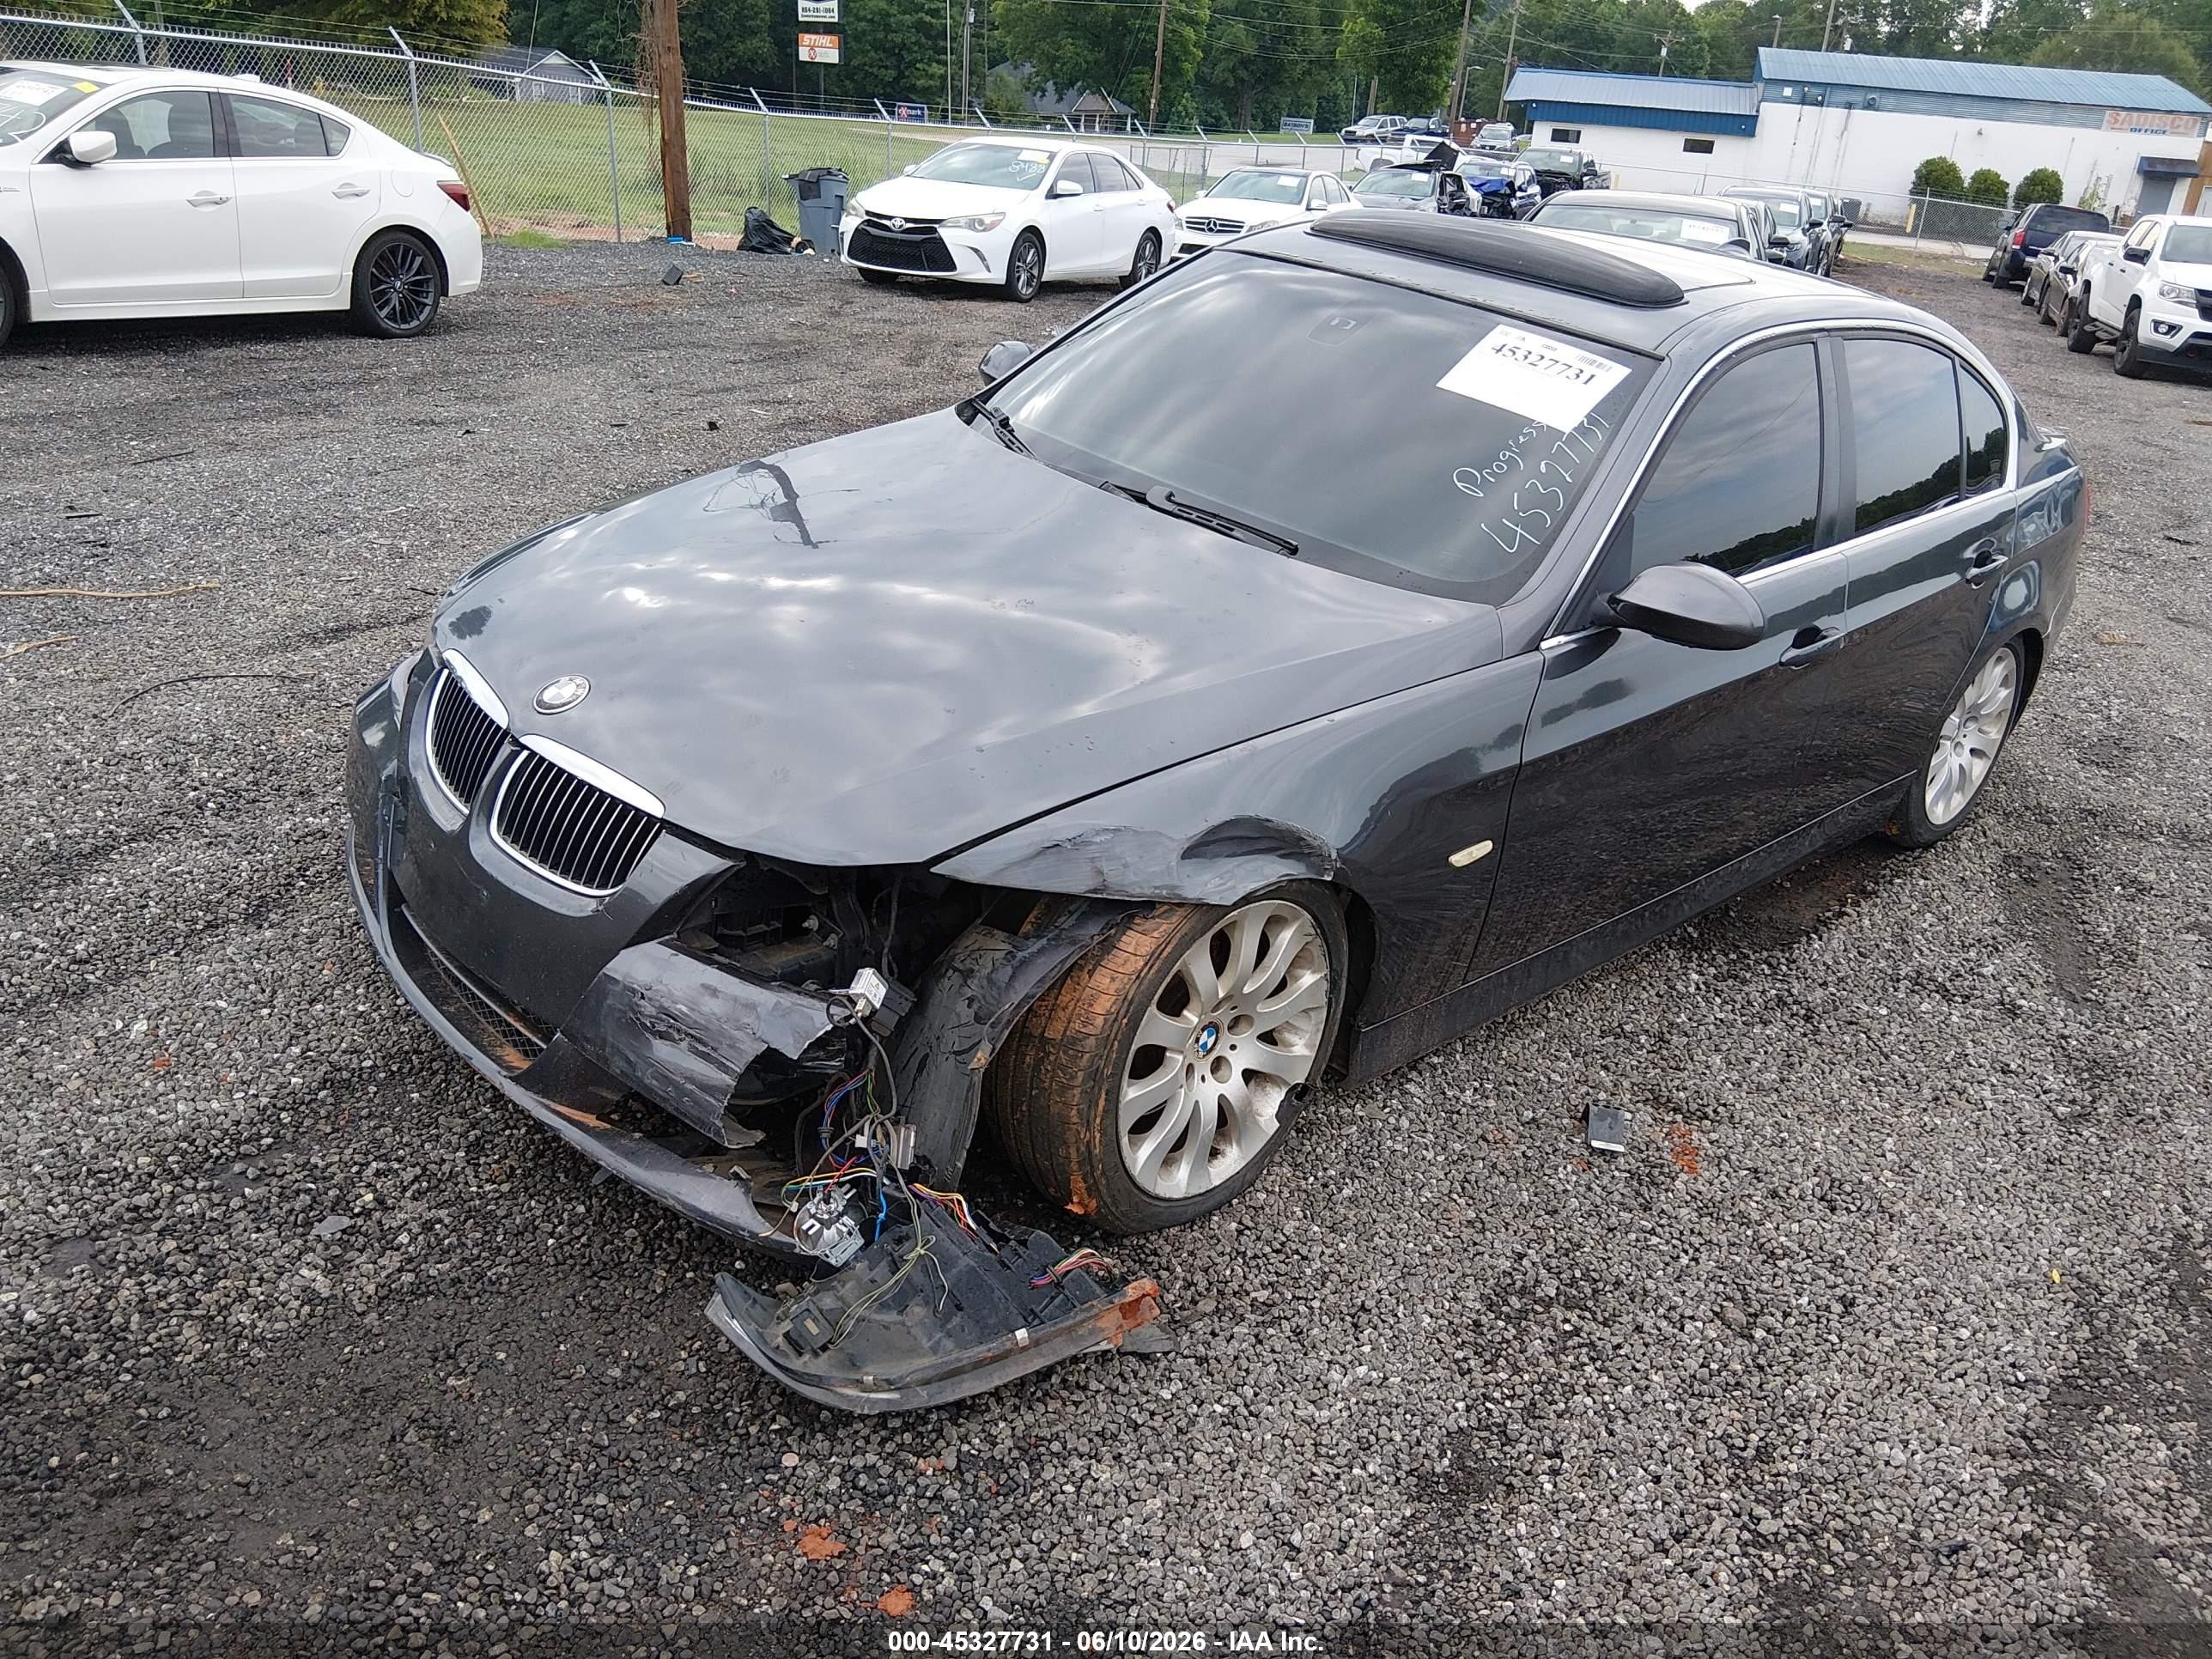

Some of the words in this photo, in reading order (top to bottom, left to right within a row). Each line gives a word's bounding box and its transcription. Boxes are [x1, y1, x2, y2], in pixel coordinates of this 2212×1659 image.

[802, 35, 833, 47] STIHL
[2107, 112, 2198, 130] SADISCO
[2130, 126, 2169, 135] OFFICE
[1491, 342, 1597, 386] 45327731
[1481, 412, 1610, 553] 45327731
